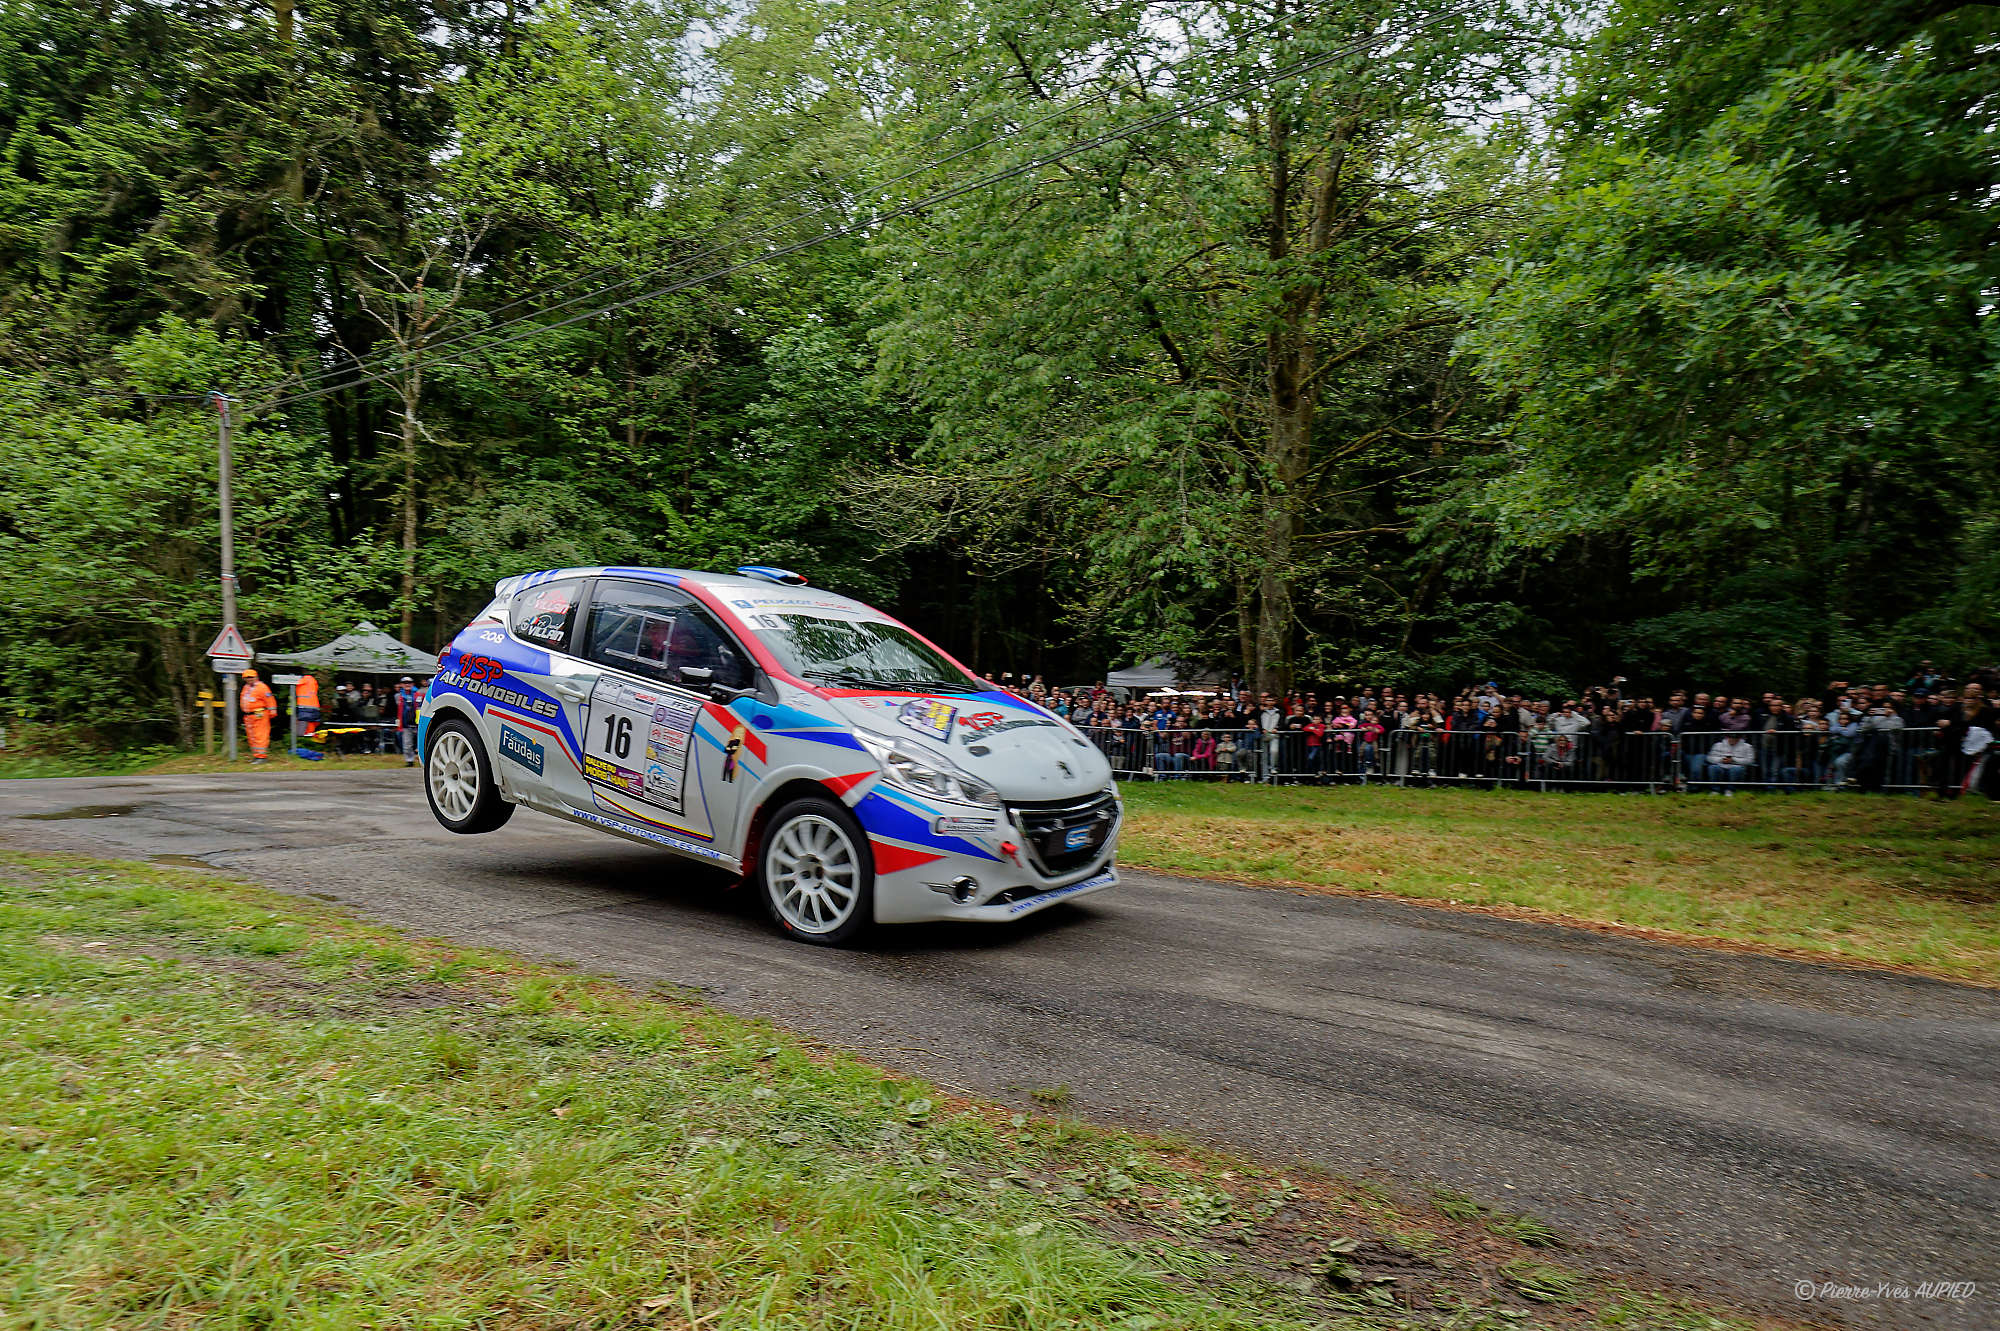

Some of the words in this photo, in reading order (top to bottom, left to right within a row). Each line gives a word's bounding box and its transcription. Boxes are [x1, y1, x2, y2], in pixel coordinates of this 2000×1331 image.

[480, 630, 505, 645] 208
[527, 624, 565, 642] VILLAIN
[749, 614, 779, 629] 16
[459, 652, 505, 684] VSP
[439, 670, 560, 719] AUTOMOBILES
[502, 730, 542, 765] Faudais
[604, 713, 633, 760] 16
